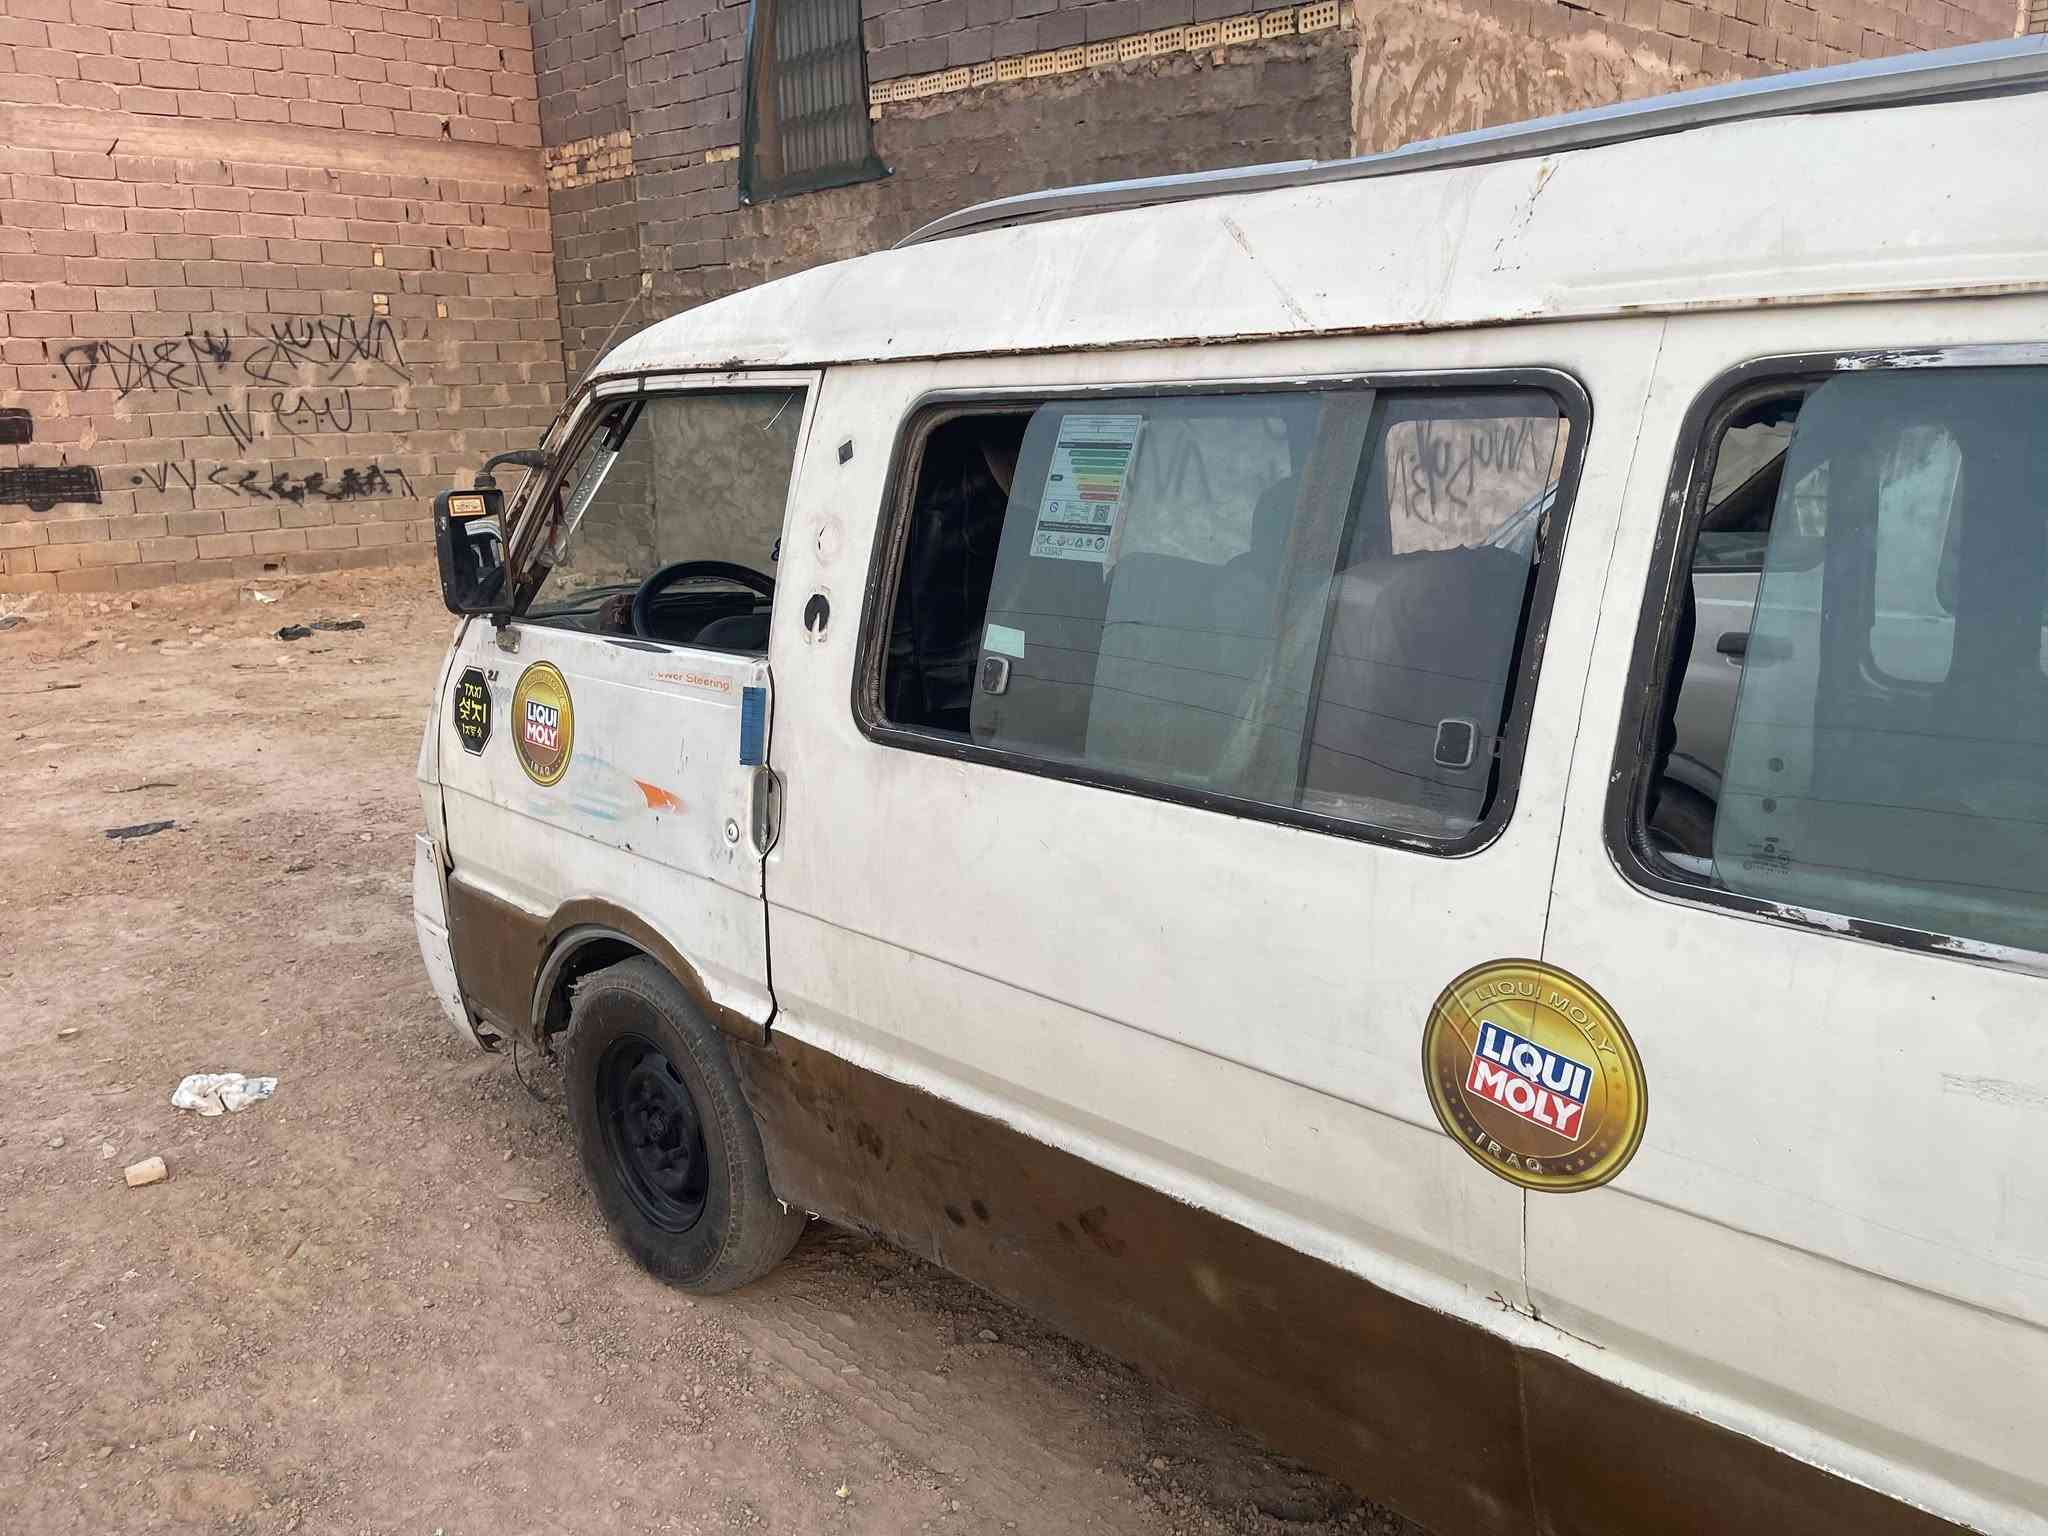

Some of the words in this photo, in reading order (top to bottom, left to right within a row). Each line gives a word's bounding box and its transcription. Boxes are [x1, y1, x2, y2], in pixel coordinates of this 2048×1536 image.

[526, 722, 558, 747] MOLY
[527, 701, 558, 728] LIQUI
[1475, 981, 1543, 1001] LIQUI
[1549, 991, 1617, 1055] MOLY
[1481, 1027, 1587, 1099] LIQUI
[1473, 1061, 1582, 1131] MOLY
[1475, 1132, 1545, 1175] IRAQ
